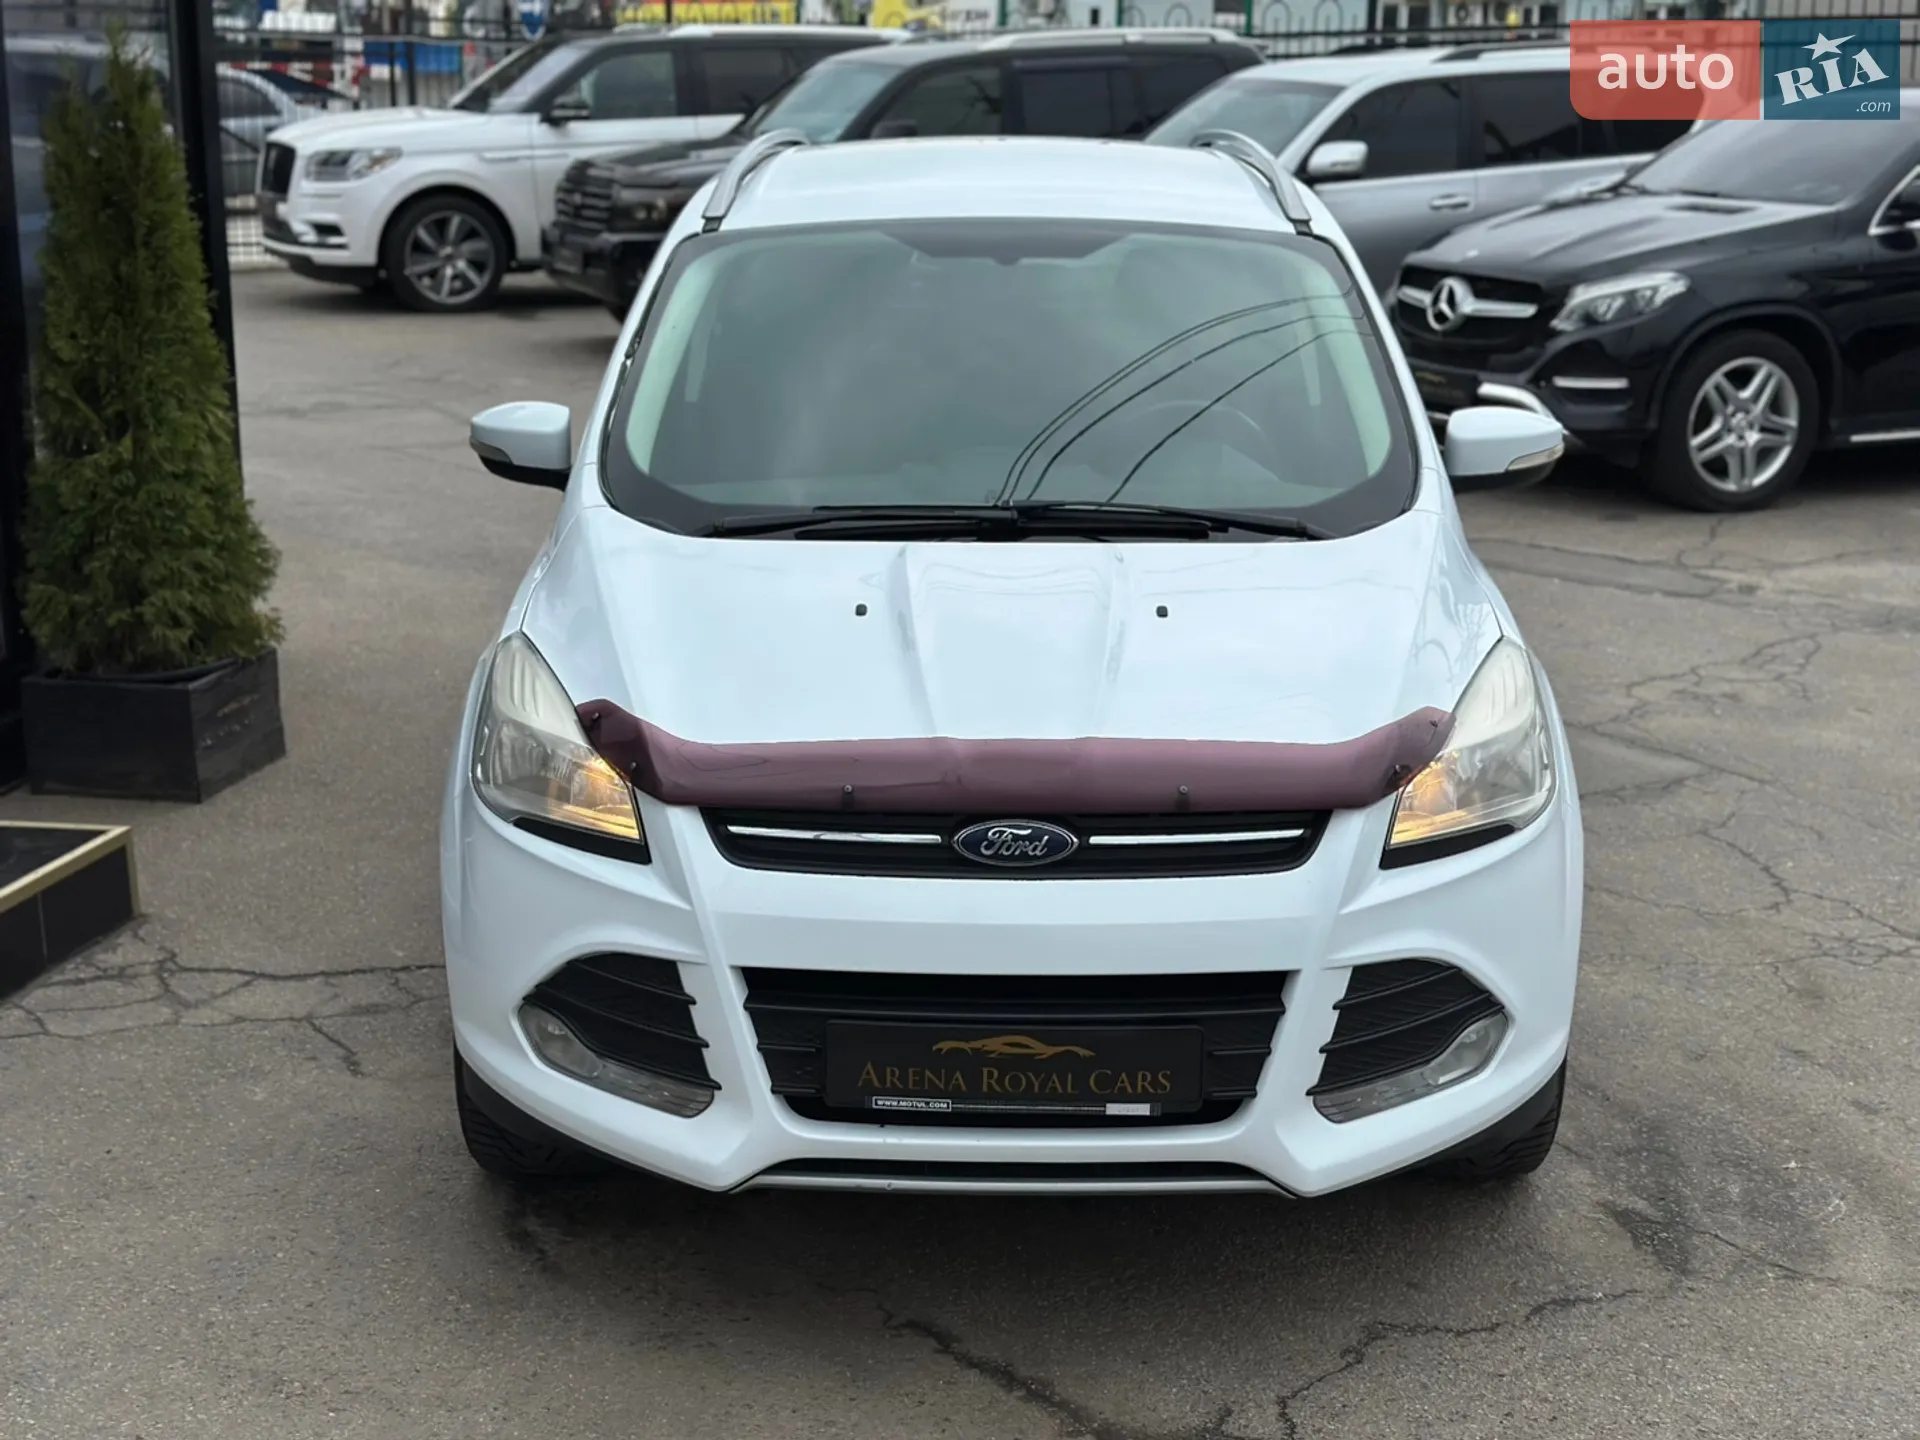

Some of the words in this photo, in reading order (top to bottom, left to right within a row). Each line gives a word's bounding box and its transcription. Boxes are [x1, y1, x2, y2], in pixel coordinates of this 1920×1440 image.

[980, 827, 1049, 856] Ford
[857, 1062, 967, 1092] ARENA
[982, 1067, 1079, 1095] ROYAL
[1089, 1069, 1172, 1095] CARS
[876, 1099, 948, 1109] WWW.MOTUL.COM
